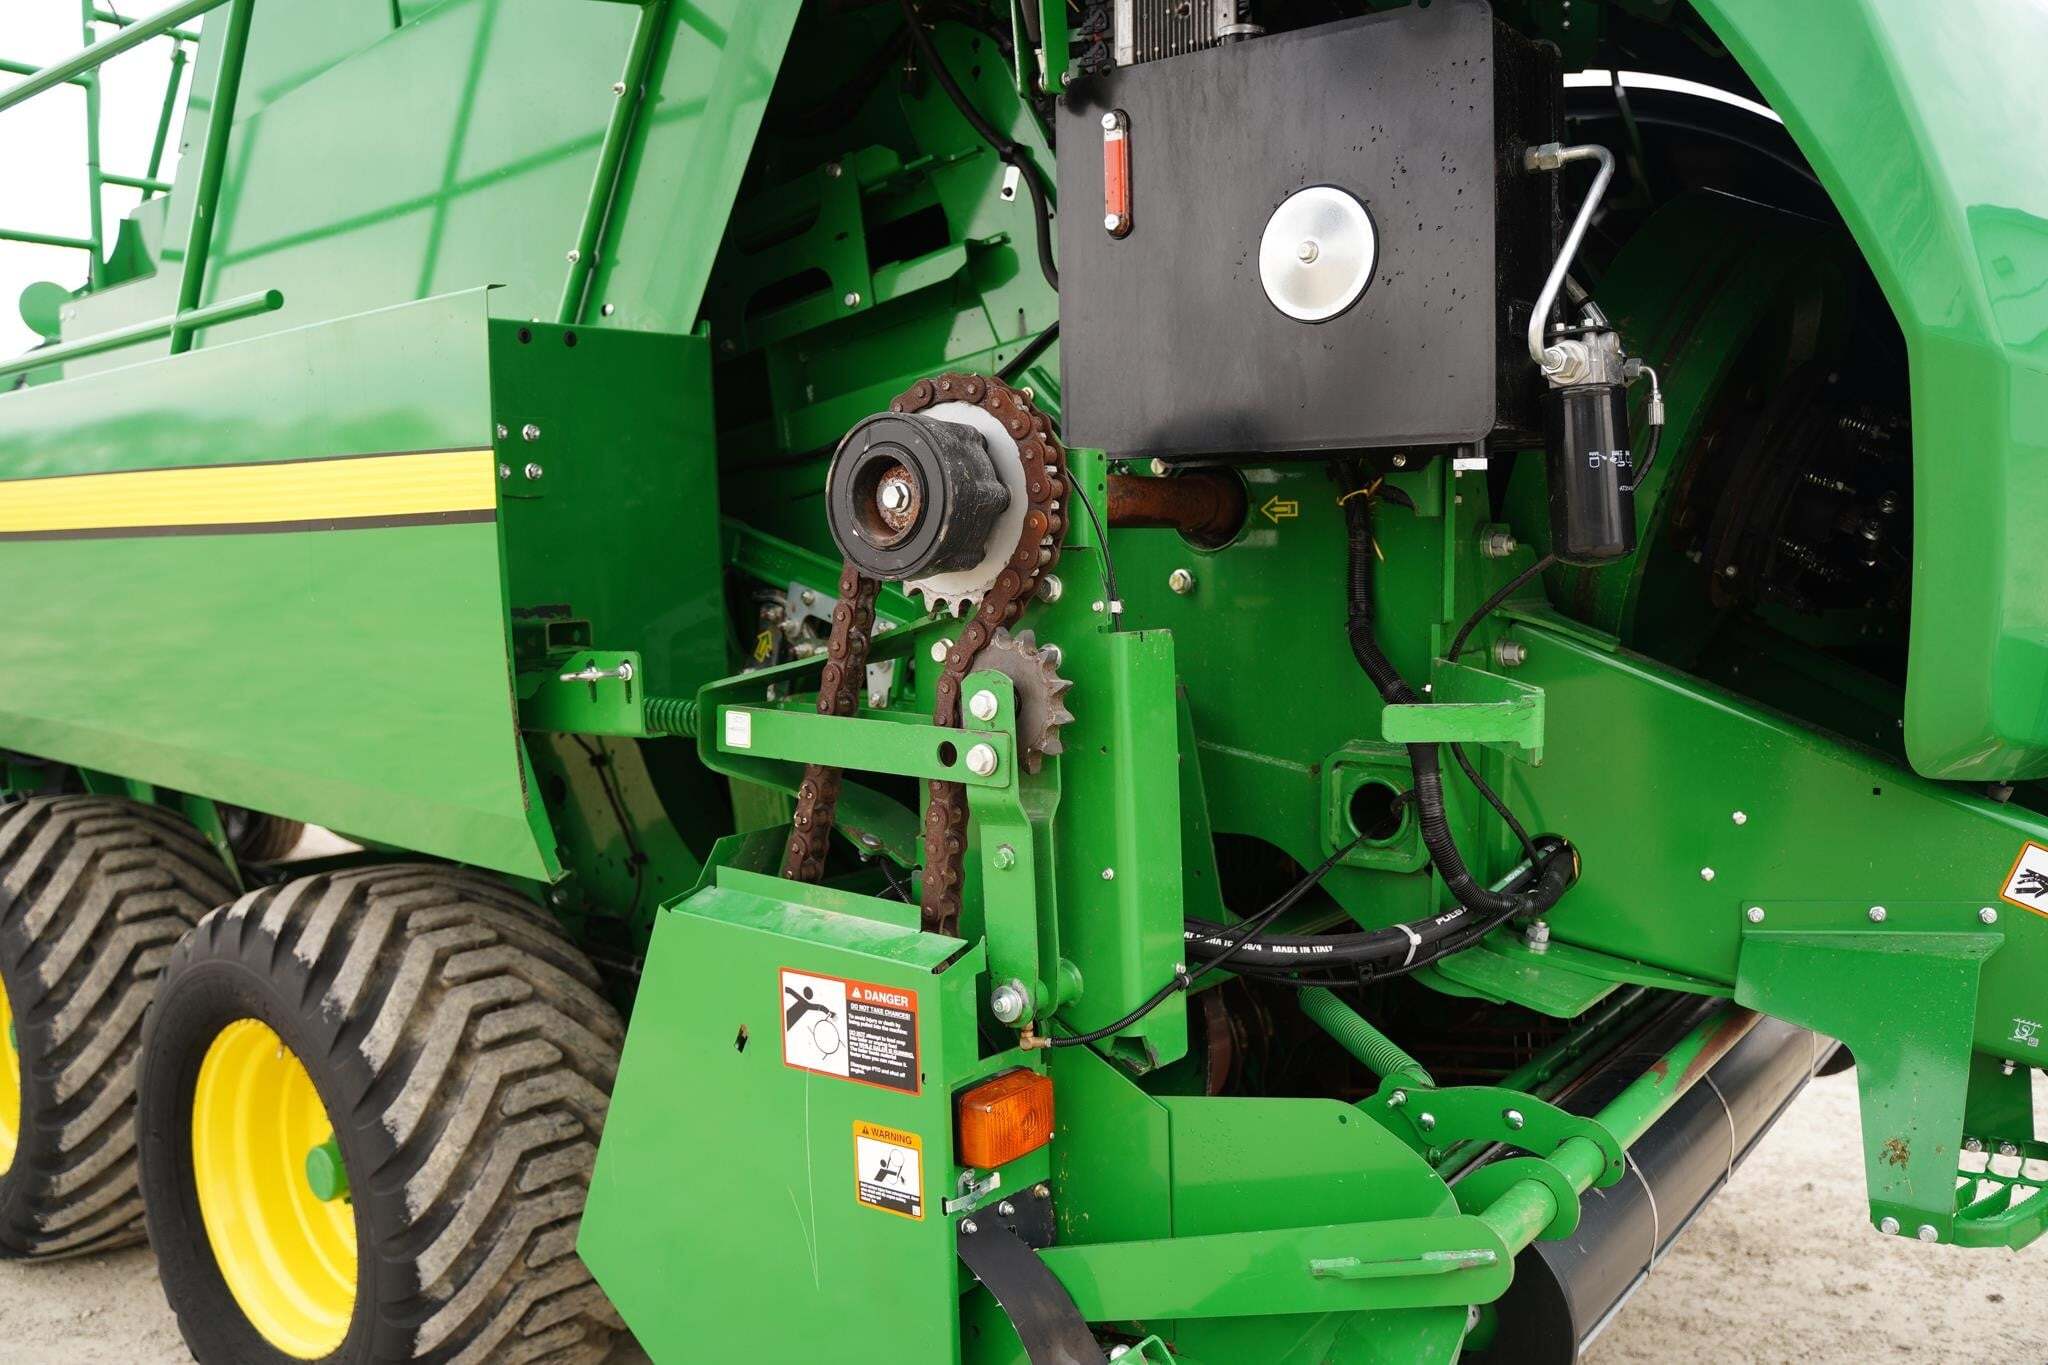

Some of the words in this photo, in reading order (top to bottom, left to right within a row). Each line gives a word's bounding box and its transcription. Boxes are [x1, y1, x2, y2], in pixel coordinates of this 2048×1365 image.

[1272, 945, 1298, 954] MADE
[1299, 945, 1311, 954] IN
[1312, 944, 1333, 953] ITALY
[864, 989, 909, 1007] DANGER
[858, 1004, 870, 1013] NOT
[871, 1006, 884, 1016] TAKE
[871, 1128, 912, 1144] WARNING
